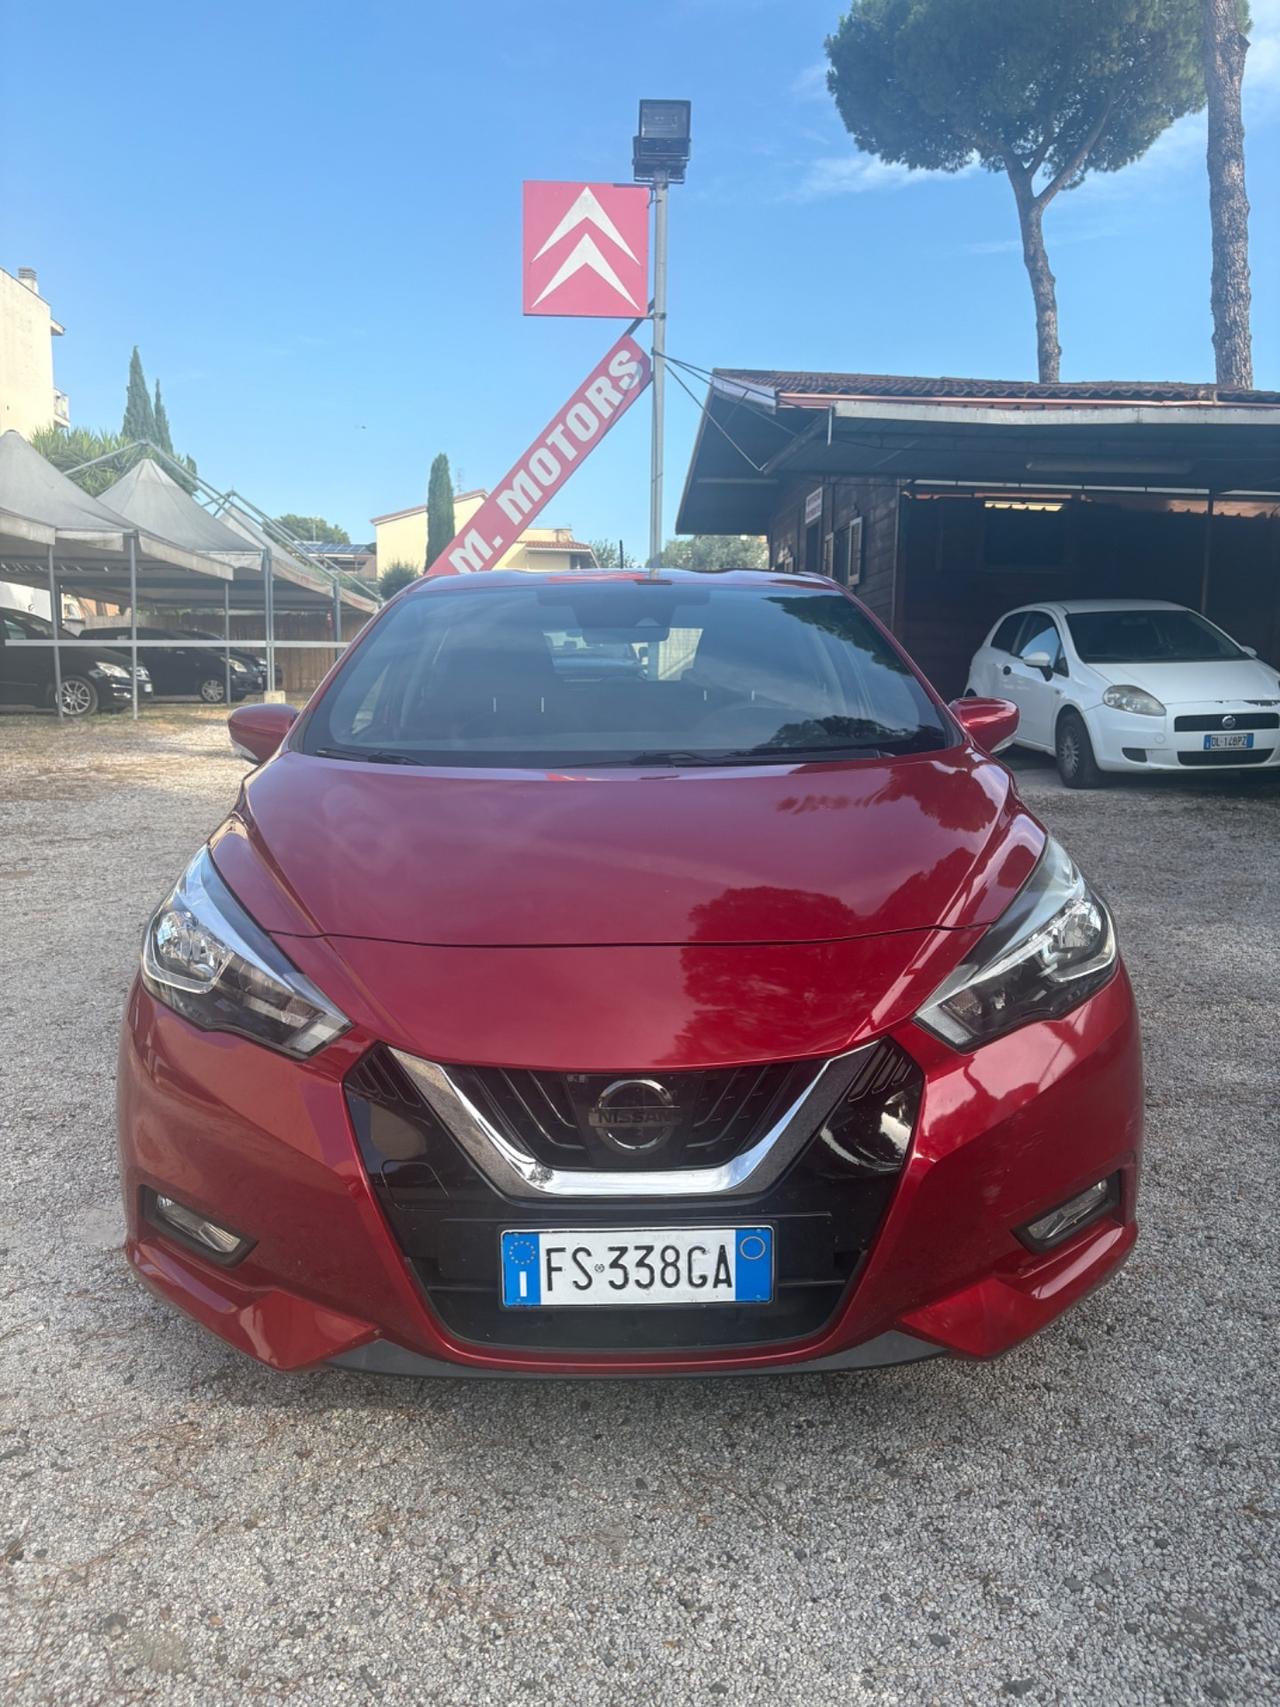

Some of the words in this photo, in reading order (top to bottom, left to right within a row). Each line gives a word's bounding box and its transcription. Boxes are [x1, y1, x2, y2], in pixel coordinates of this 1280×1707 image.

[448, 528, 504, 574] M.
[496, 350, 643, 525] MOTORS
[598, 1109, 672, 1124] NISSAN
